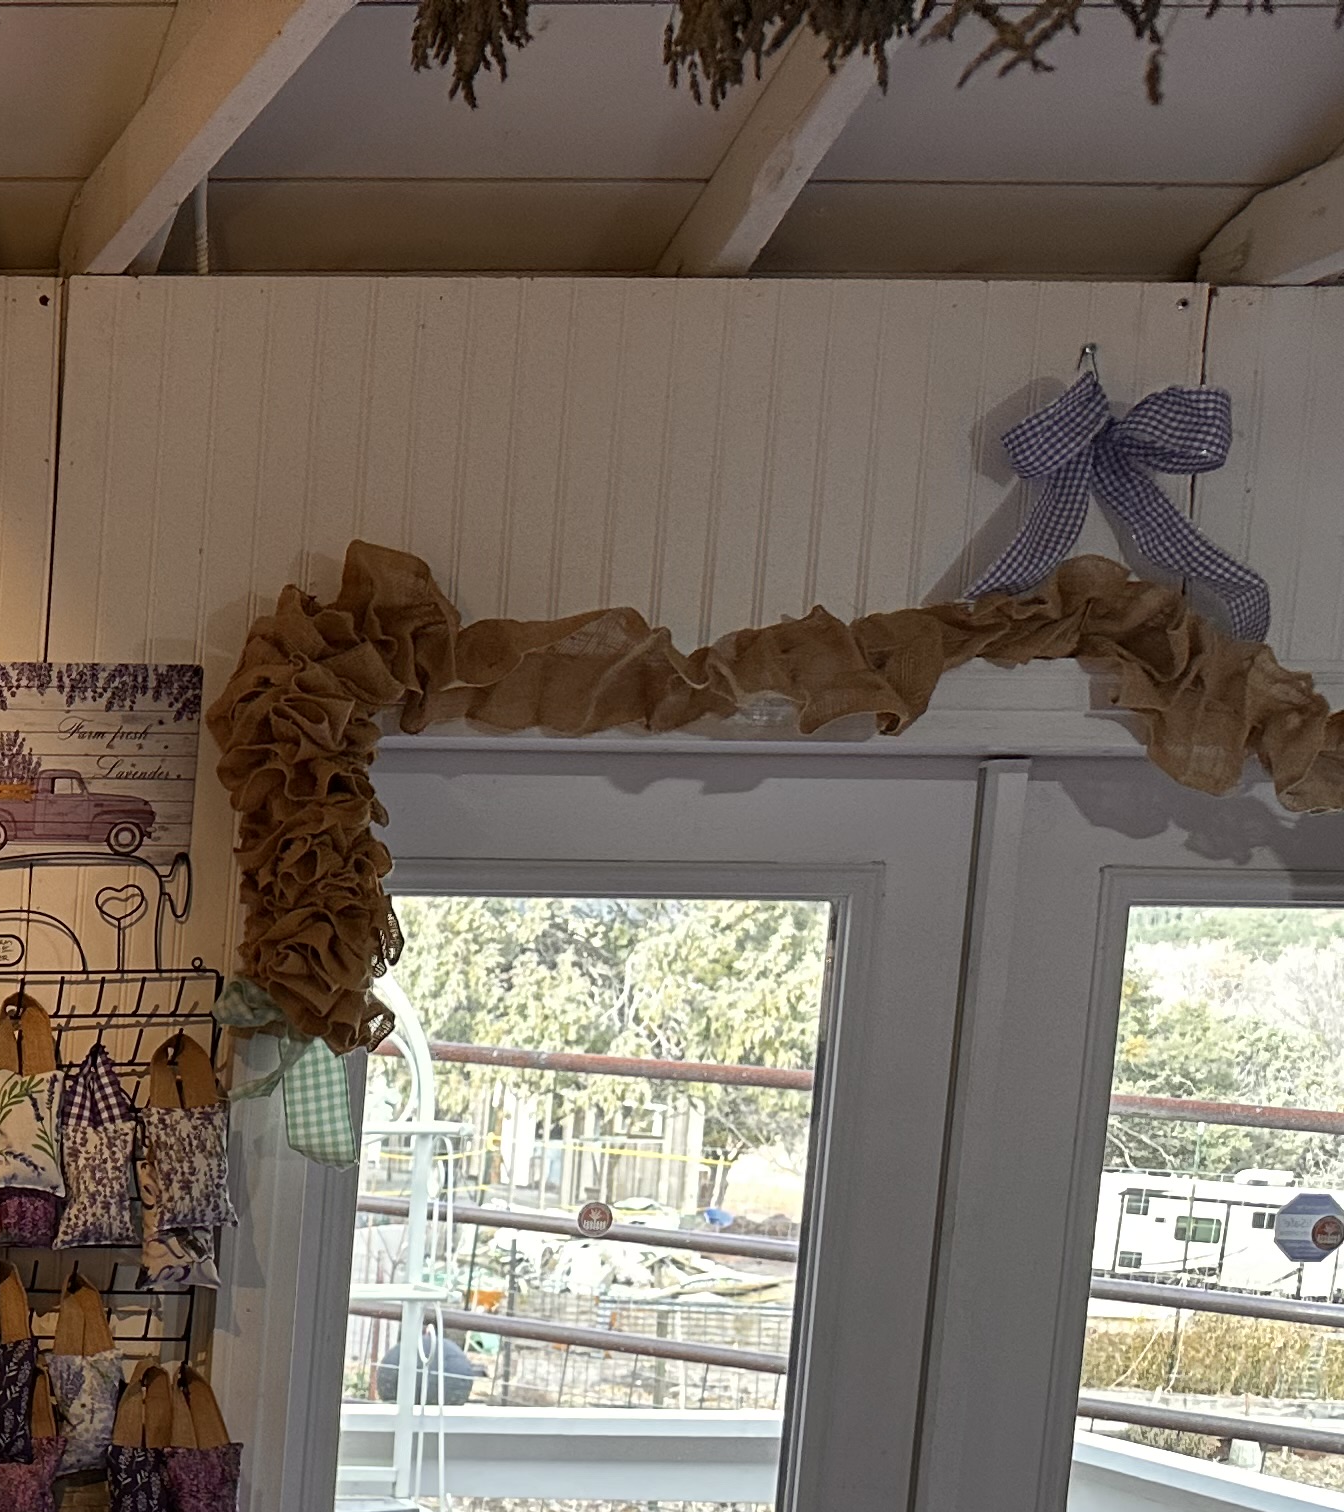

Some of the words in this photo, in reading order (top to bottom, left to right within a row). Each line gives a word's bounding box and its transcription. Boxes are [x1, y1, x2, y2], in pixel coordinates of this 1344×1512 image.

[58, 716, 106, 740] Farm
[106, 724, 152, 749] fresh
[94, 755, 170, 779] Lavender
